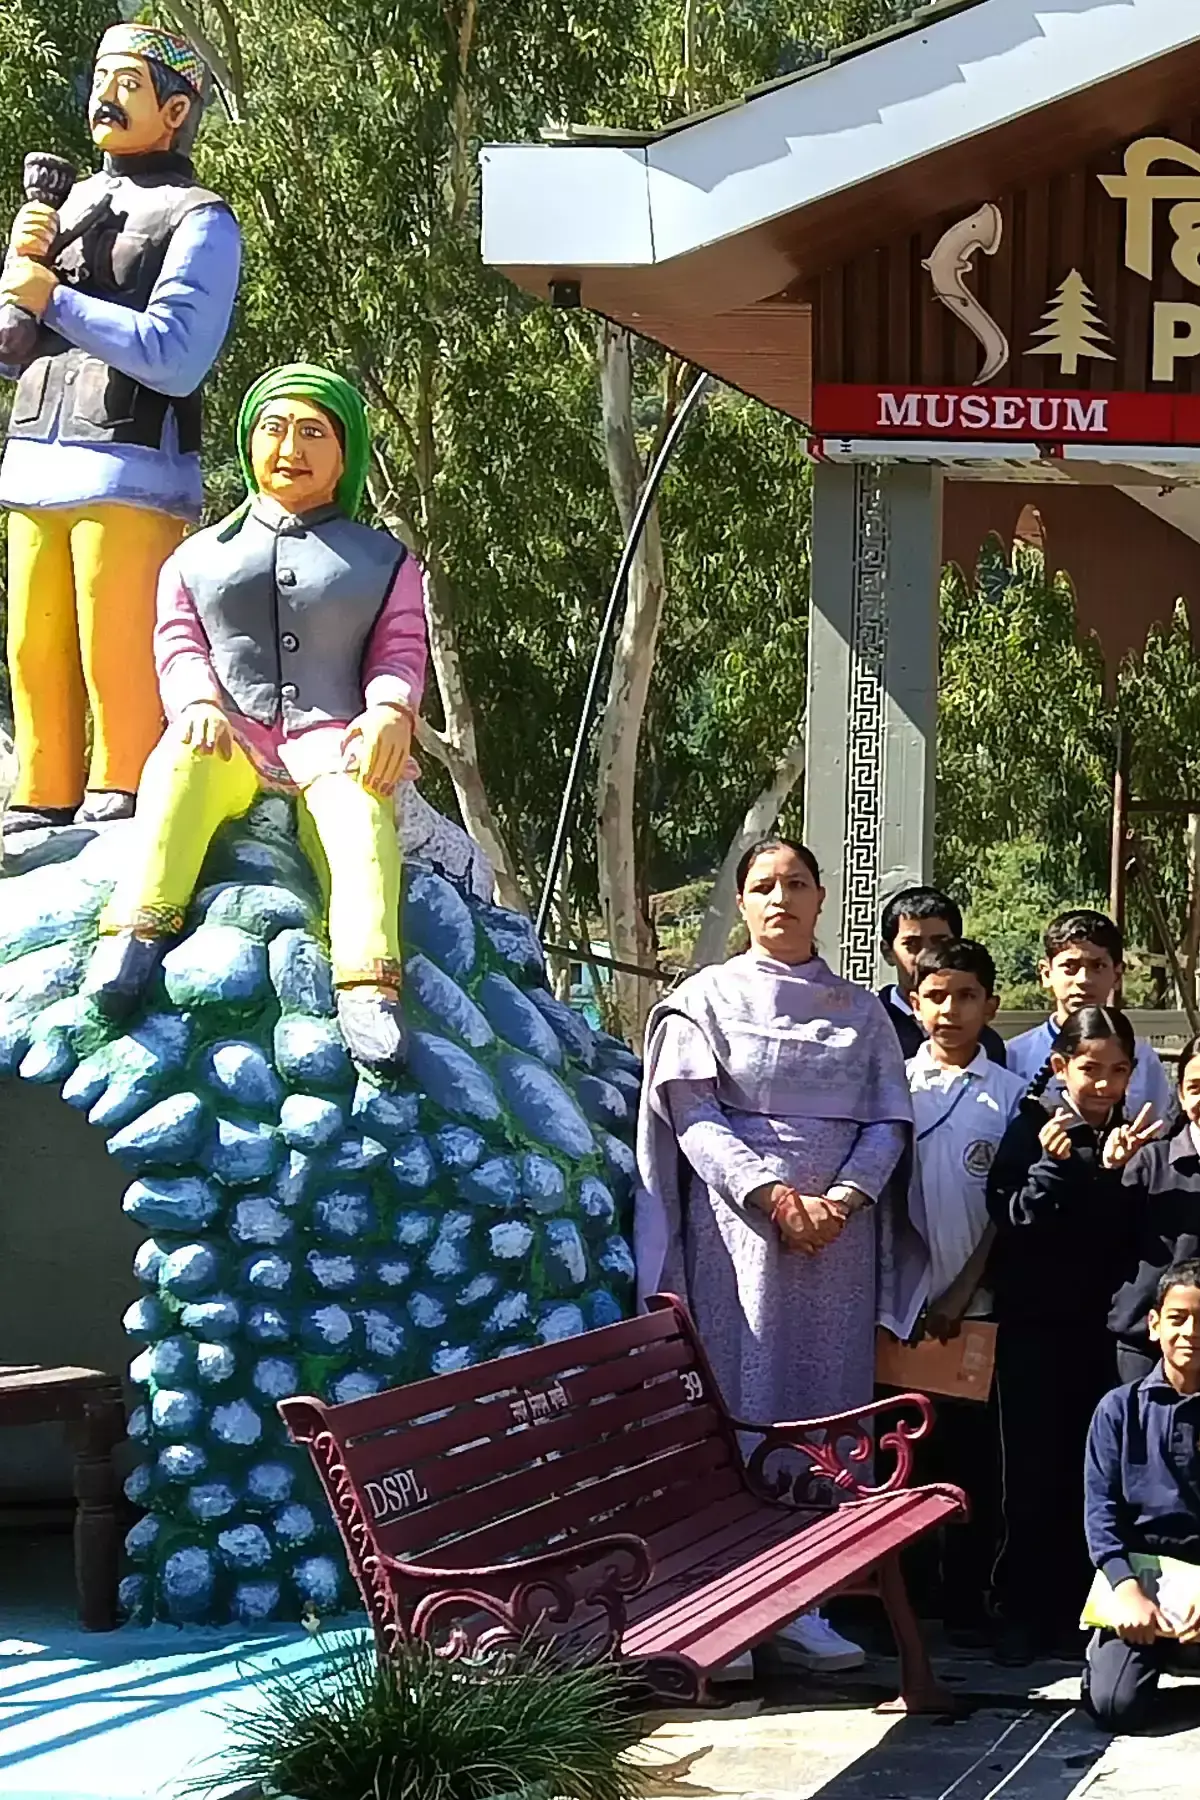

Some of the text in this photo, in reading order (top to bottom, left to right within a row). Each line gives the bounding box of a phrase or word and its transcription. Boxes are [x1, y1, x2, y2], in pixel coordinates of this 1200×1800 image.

[876, 392, 1109, 433] MUSEUM
[680, 1371, 703, 1401] 39
[363, 1469, 428, 1519] DSPL
